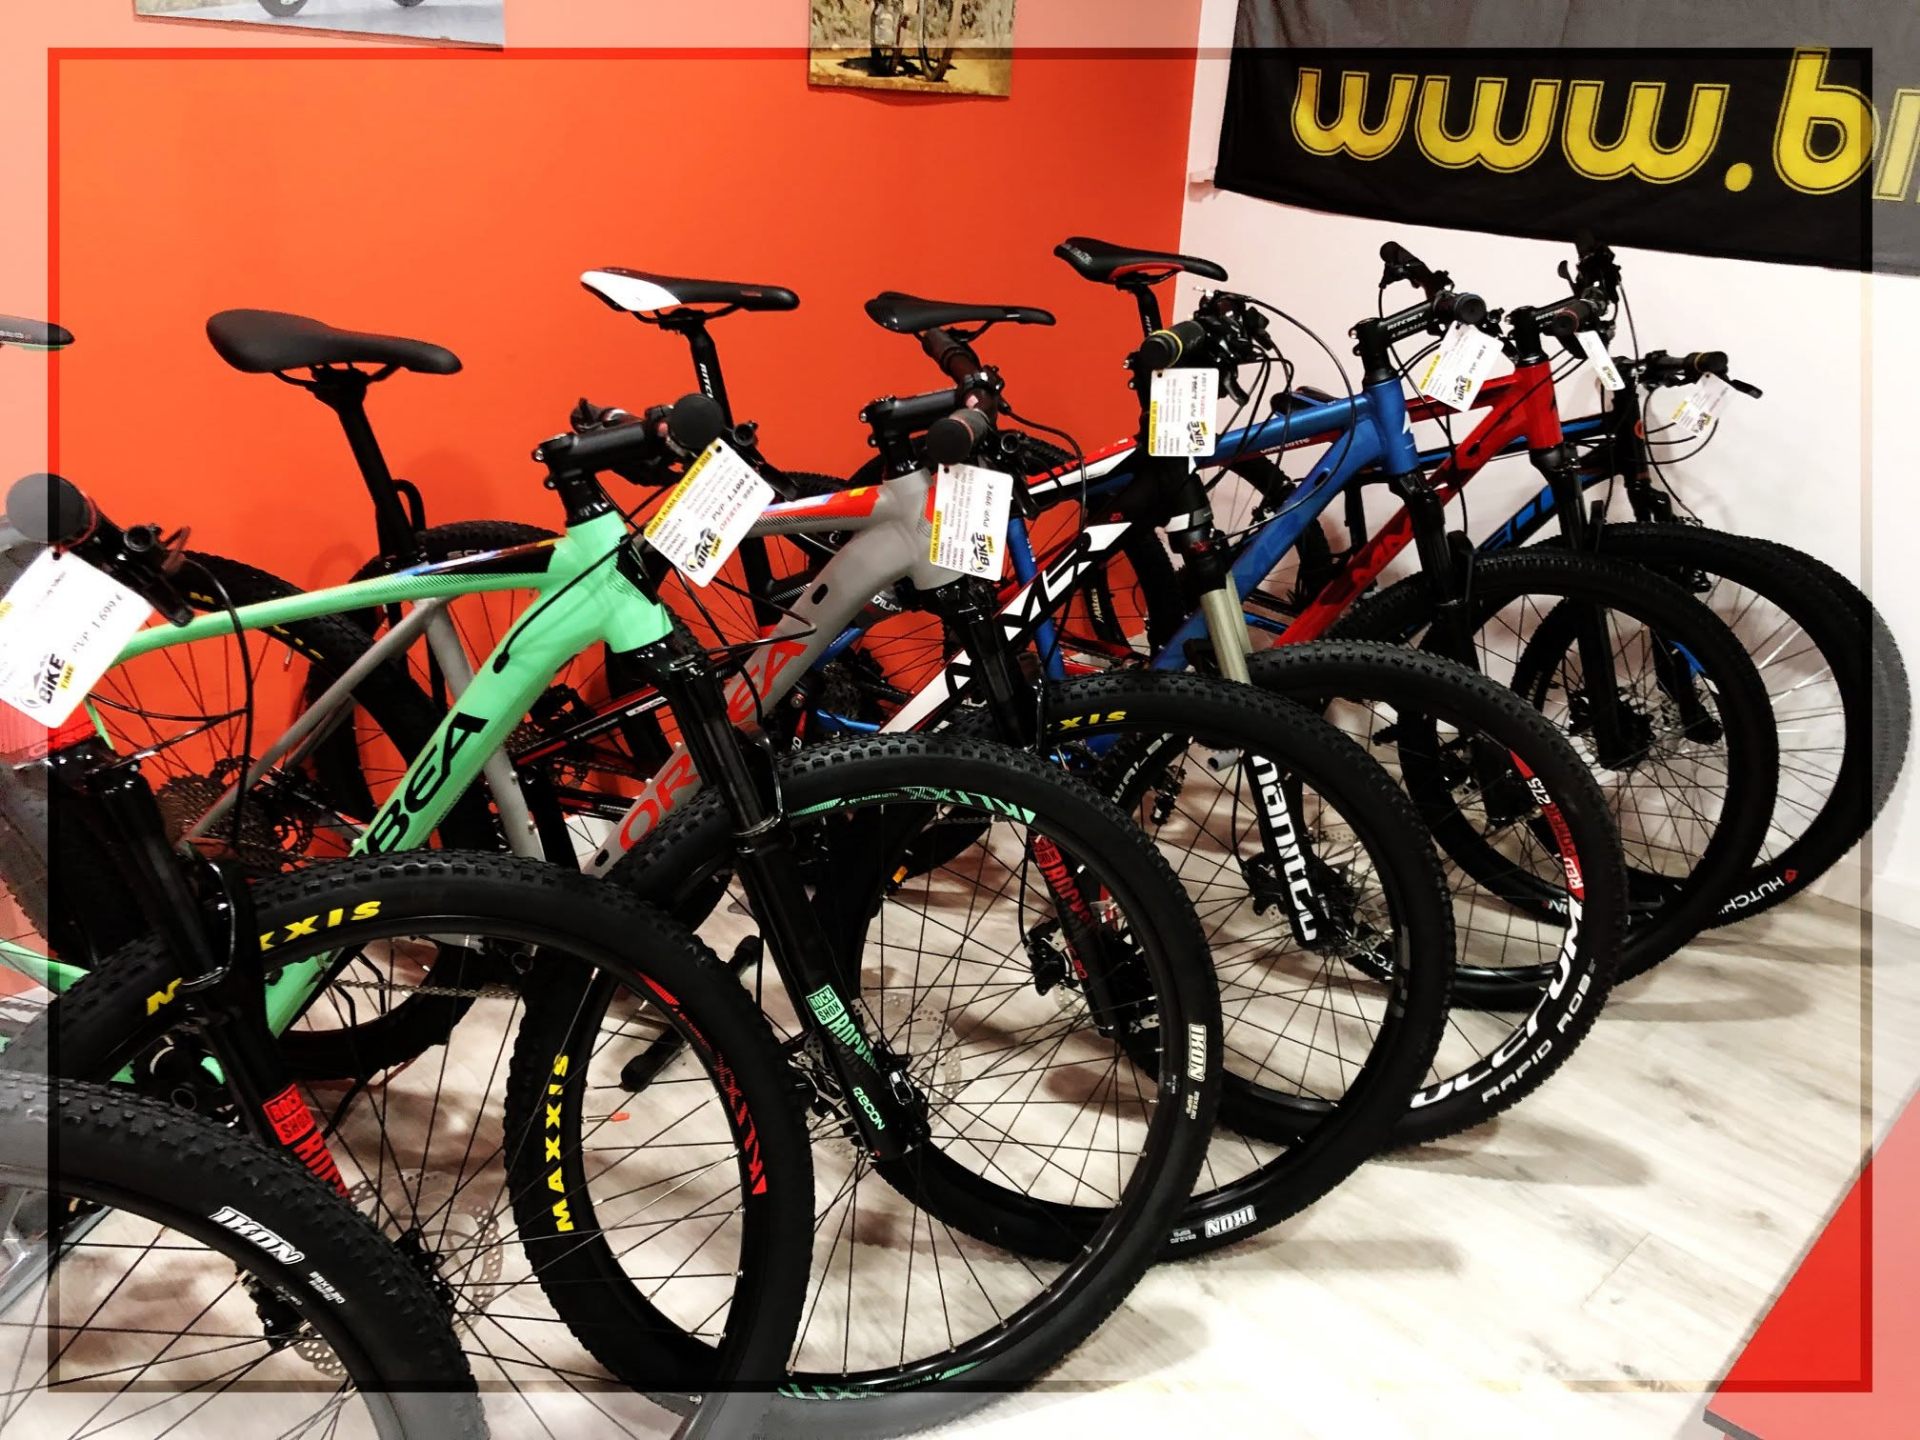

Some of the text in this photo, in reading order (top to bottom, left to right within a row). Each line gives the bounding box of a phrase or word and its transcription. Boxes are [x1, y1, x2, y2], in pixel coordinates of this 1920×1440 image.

[697, 532, 718, 568] BIKE
[979, 533, 989, 567] BIKE
[40, 653, 66, 705] BIKE
[619, 642, 808, 851] OREA
[1047, 711, 1127, 731] XIS
[352, 713, 488, 857] BEA
[147, 901, 381, 1016] MXXIS
[808, 987, 834, 1010] ROCK
[817, 1000, 841, 1021] SHOX
[1187, 1023, 1207, 1083] IKON
[1482, 1039, 1553, 1104] RAPID
[851, 1085, 886, 1131] RECON
[546, 1054, 574, 1233] MAXXIS
[207, 1206, 306, 1266] IKON
[1205, 1205, 1258, 1239] IKON
